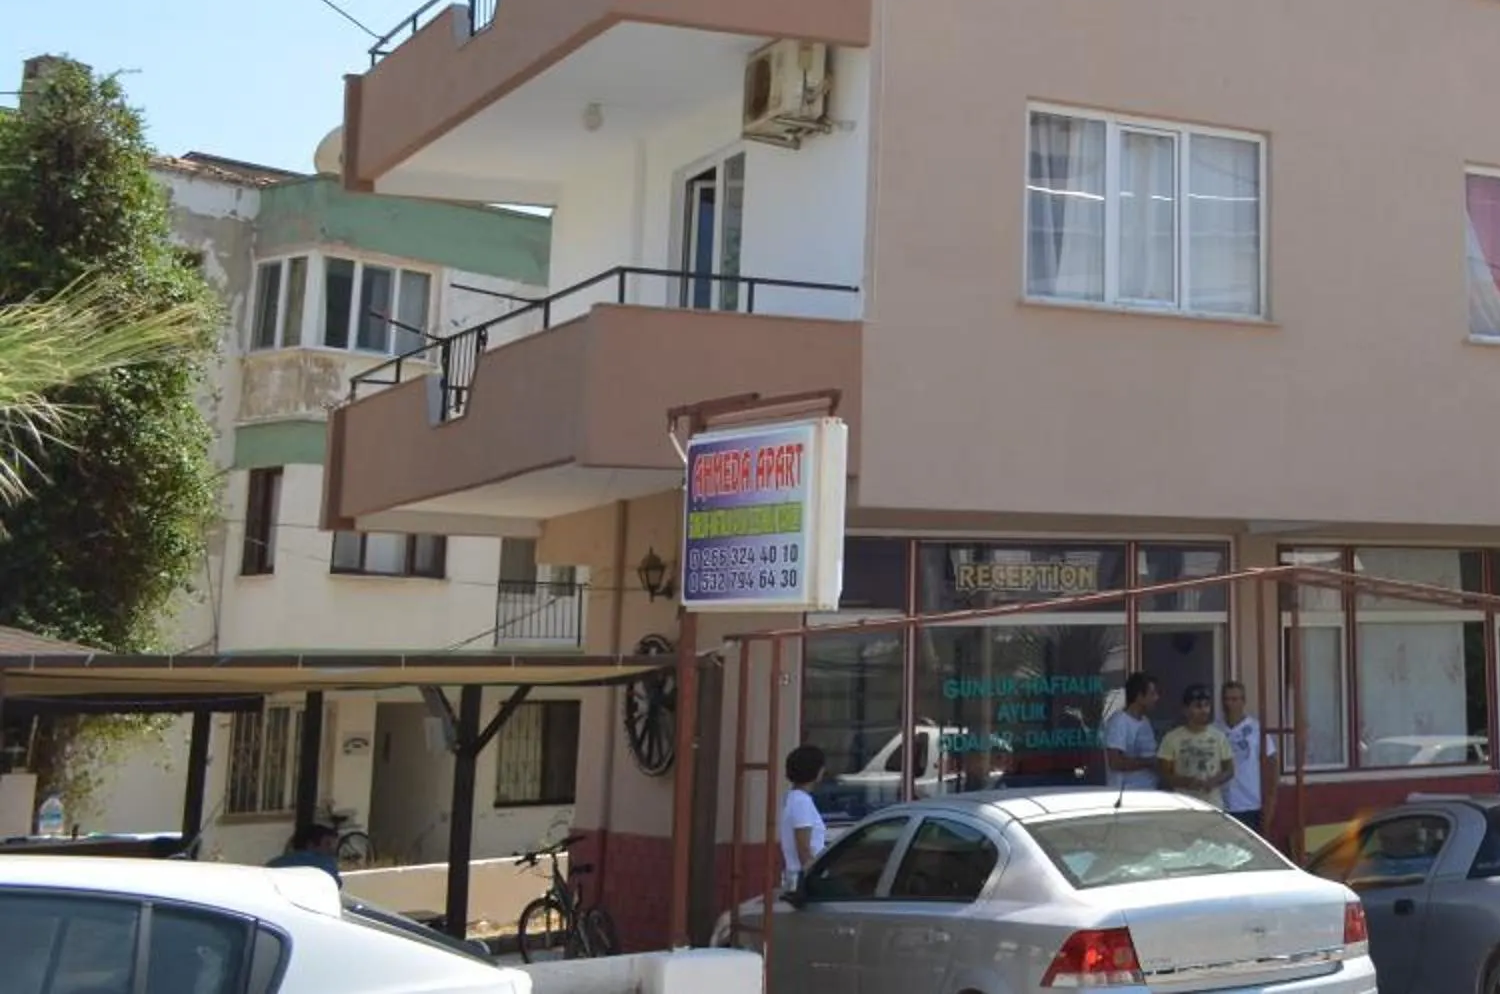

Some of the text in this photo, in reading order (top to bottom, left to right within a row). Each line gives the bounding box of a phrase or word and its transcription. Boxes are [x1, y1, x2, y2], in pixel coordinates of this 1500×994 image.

[756, 444, 804, 489] APART
[760, 544, 777, 564] 40
[782, 543, 799, 563] 10
[759, 569, 776, 589] 64
[780, 568, 798, 588] 30
[957, 563, 1095, 590] RECEPTION
